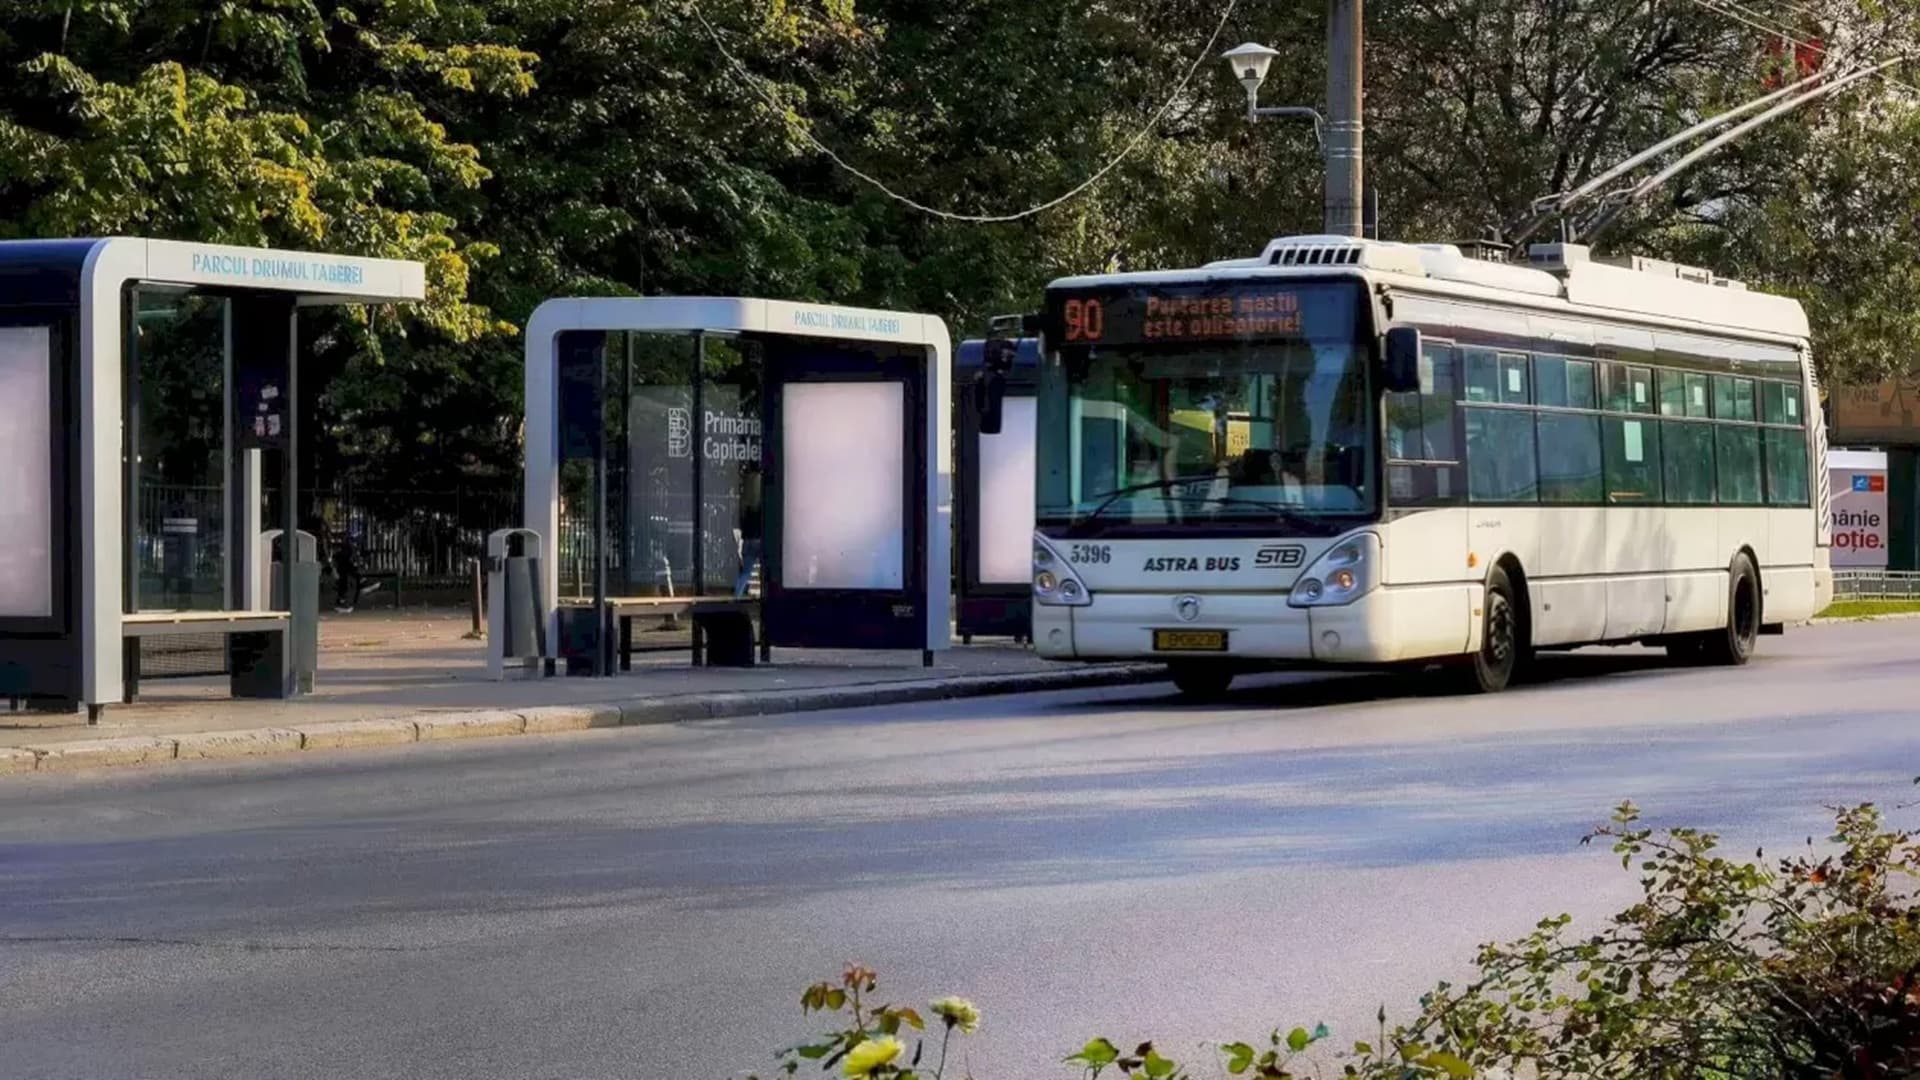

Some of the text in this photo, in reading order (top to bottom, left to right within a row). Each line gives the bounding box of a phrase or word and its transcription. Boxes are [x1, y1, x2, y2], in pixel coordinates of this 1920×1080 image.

[192, 253, 363, 285] PARCUL DRUMUL TABEREI
[1064, 298, 1104, 341] 90
[1143, 318, 1182, 338] este
[704, 410, 761, 435] Primăria
[703, 437, 763, 466] Capitalei
[1830, 529, 1884, 552] oție.
[1070, 545, 1111, 565] 5396
[1143, 556, 1241, 572] ASTRA BUS
[1254, 547, 1303, 566] STB
